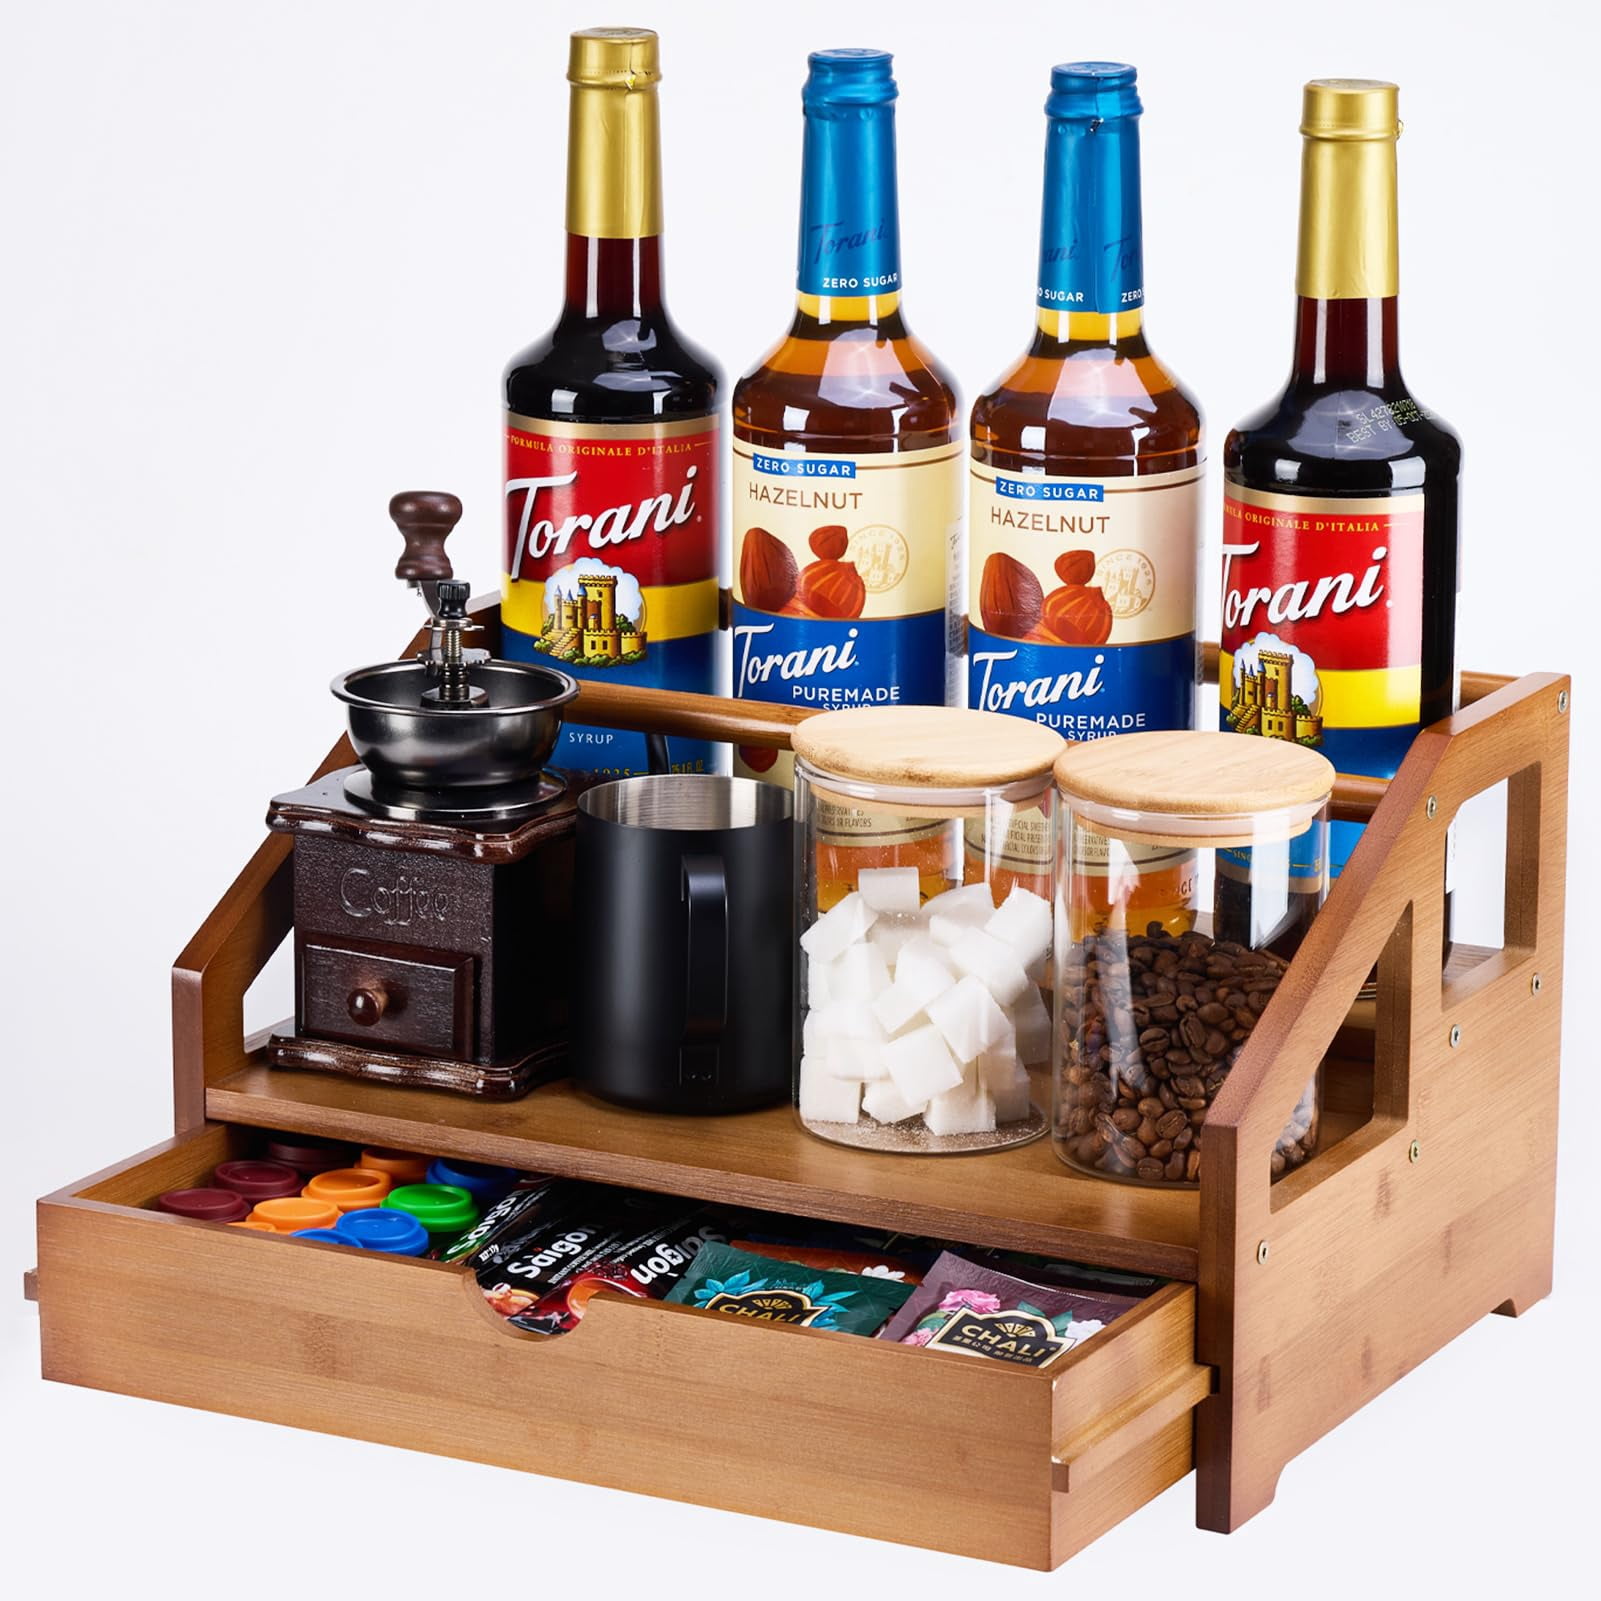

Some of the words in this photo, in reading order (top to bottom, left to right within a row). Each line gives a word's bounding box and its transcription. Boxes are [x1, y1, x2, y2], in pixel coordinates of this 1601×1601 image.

[822, 277, 859, 289] ZERO
[863, 272, 898, 288] SUGAR
[1044, 288, 1085, 303] SUGAR
[1121, 288, 1142, 303] ZERO
[510, 434, 554, 453] FORMULA
[558, 443, 632, 457] ORIGINALE
[637, 442, 692, 456] D'ITALIA
[756, 456, 790, 473] ZERO
[797, 461, 851, 476] SUGAR
[749, 481, 863, 510] HAZELNUT
[1000, 480, 1036, 497] ZERO
[1043, 485, 1098, 500] SUGAR
[504, 464, 699, 580] Torani
[991, 506, 1110, 534] HAZELNUT
[1245, 511, 1310, 530] ORIGINALE
[1315, 521, 1380, 532] D'ITALIA
[1221, 540, 1388, 648] Torani
[733, 623, 858, 698] Torani
[973, 649, 1105, 712] Torani
[792, 685, 900, 701] PUREMADE
[1035, 713, 1147, 729] PUREMADE
[568, 732, 614, 745] SYRUP
[340, 867, 449, 926] Coffee
[961, 1324, 1046, 1358] CHALI
